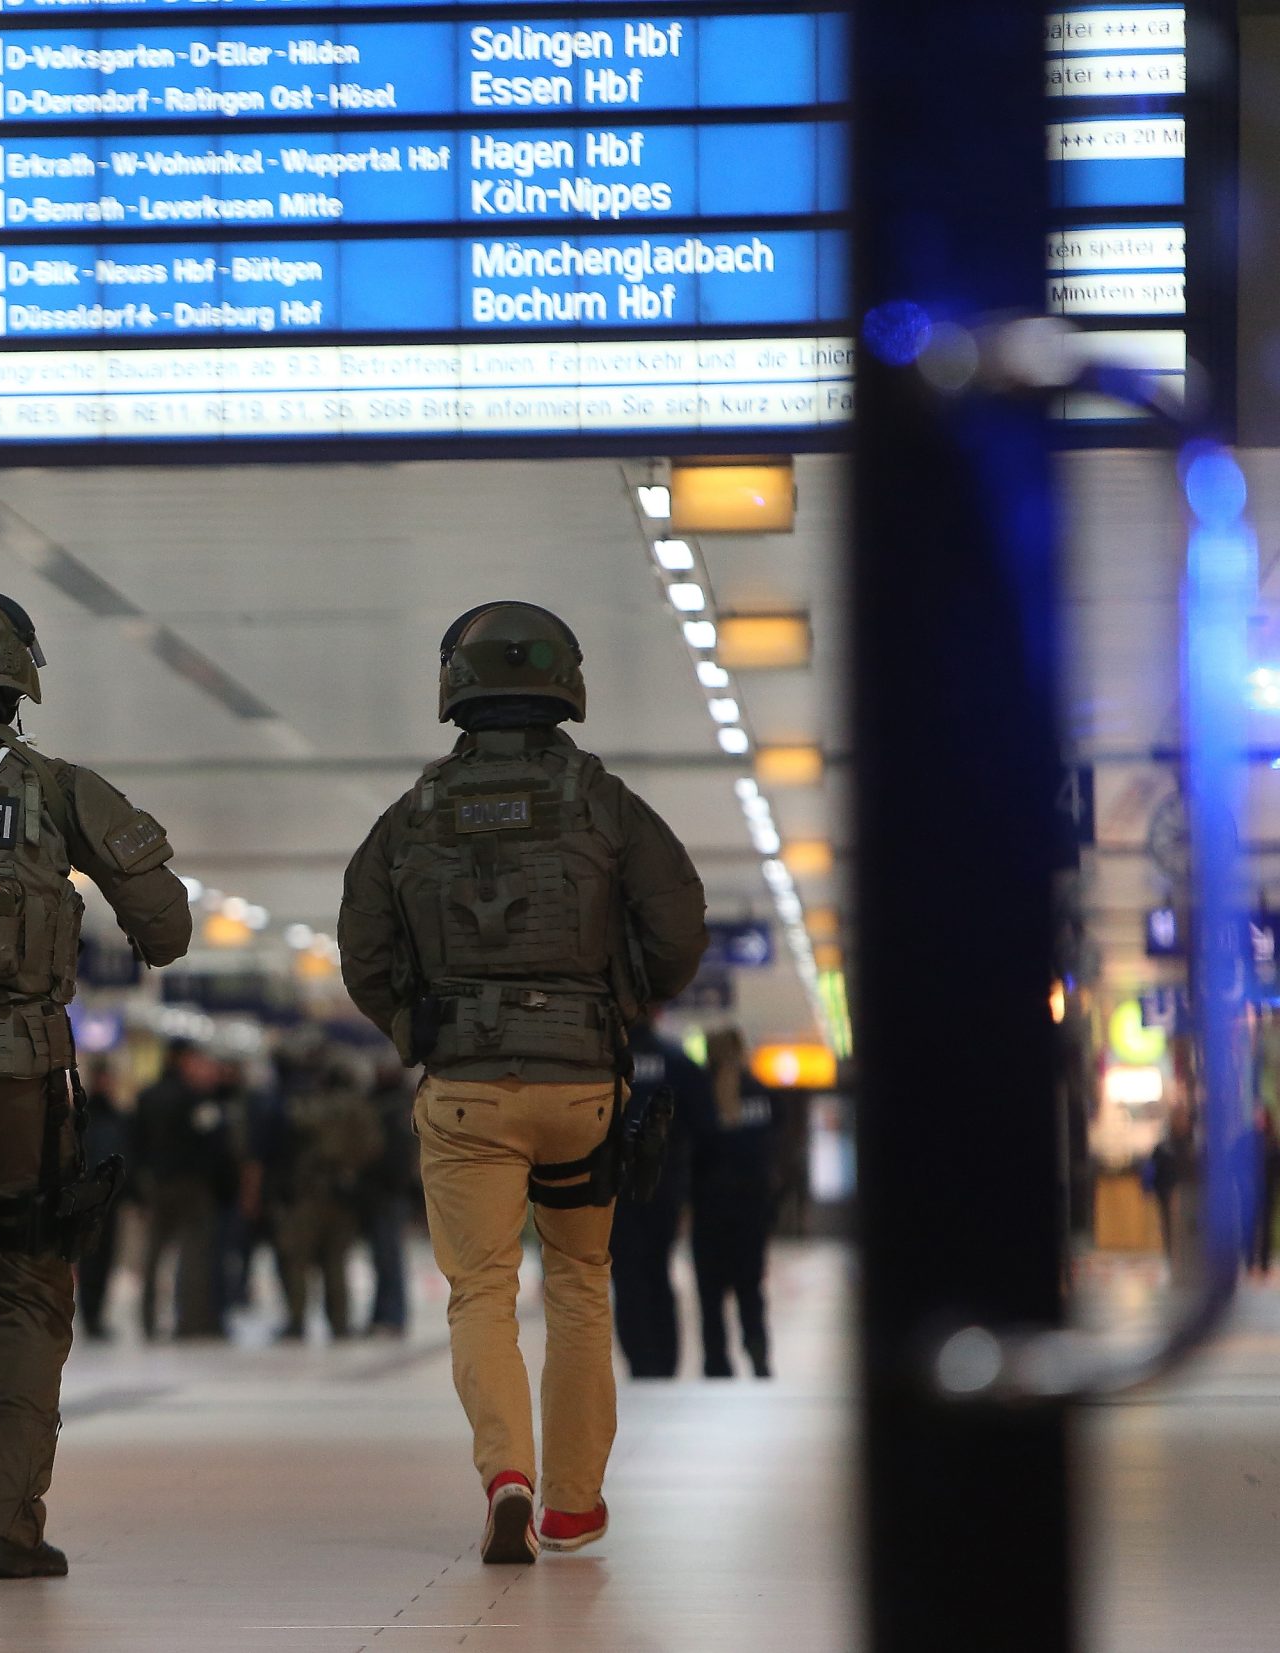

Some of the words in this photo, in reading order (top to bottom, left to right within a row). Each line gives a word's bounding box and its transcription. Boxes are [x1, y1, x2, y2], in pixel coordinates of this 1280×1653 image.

[288, 40, 360, 65] Hilden
[470, 25, 614, 68] Solingen
[624, 22, 683, 58] Hbf
[164, 86, 265, 117] Ratingen
[271, 84, 314, 109] Ost
[329, 83, 397, 109] Hösel
[470, 70, 573, 106] Essen
[585, 68, 644, 104] Hbf
[280, 146, 402, 178] Wuppertal
[408, 146, 451, 171] Hbf
[470, 135, 575, 178] Hagen
[586, 132, 645, 168] Hbf
[139, 194, 274, 221] Leverkusen
[279, 192, 344, 218] Mitte
[470, 177, 673, 220] Köln-Nippes
[95, 259, 168, 285] Neuss
[173, 258, 216, 283] Hbf
[231, 257, 322, 286] Büttgen
[471, 237, 775, 283] Mönchengladbach
[173, 302, 276, 331] Duisburg
[280, 300, 323, 325] Hbf
[471, 286, 607, 323] Bochum
[617, 283, 677, 320] Hbf
[696, 348, 736, 370] und
[758, 347, 788, 369] die
[622, 393, 655, 415] Sie
[720, 391, 769, 413] kurz
